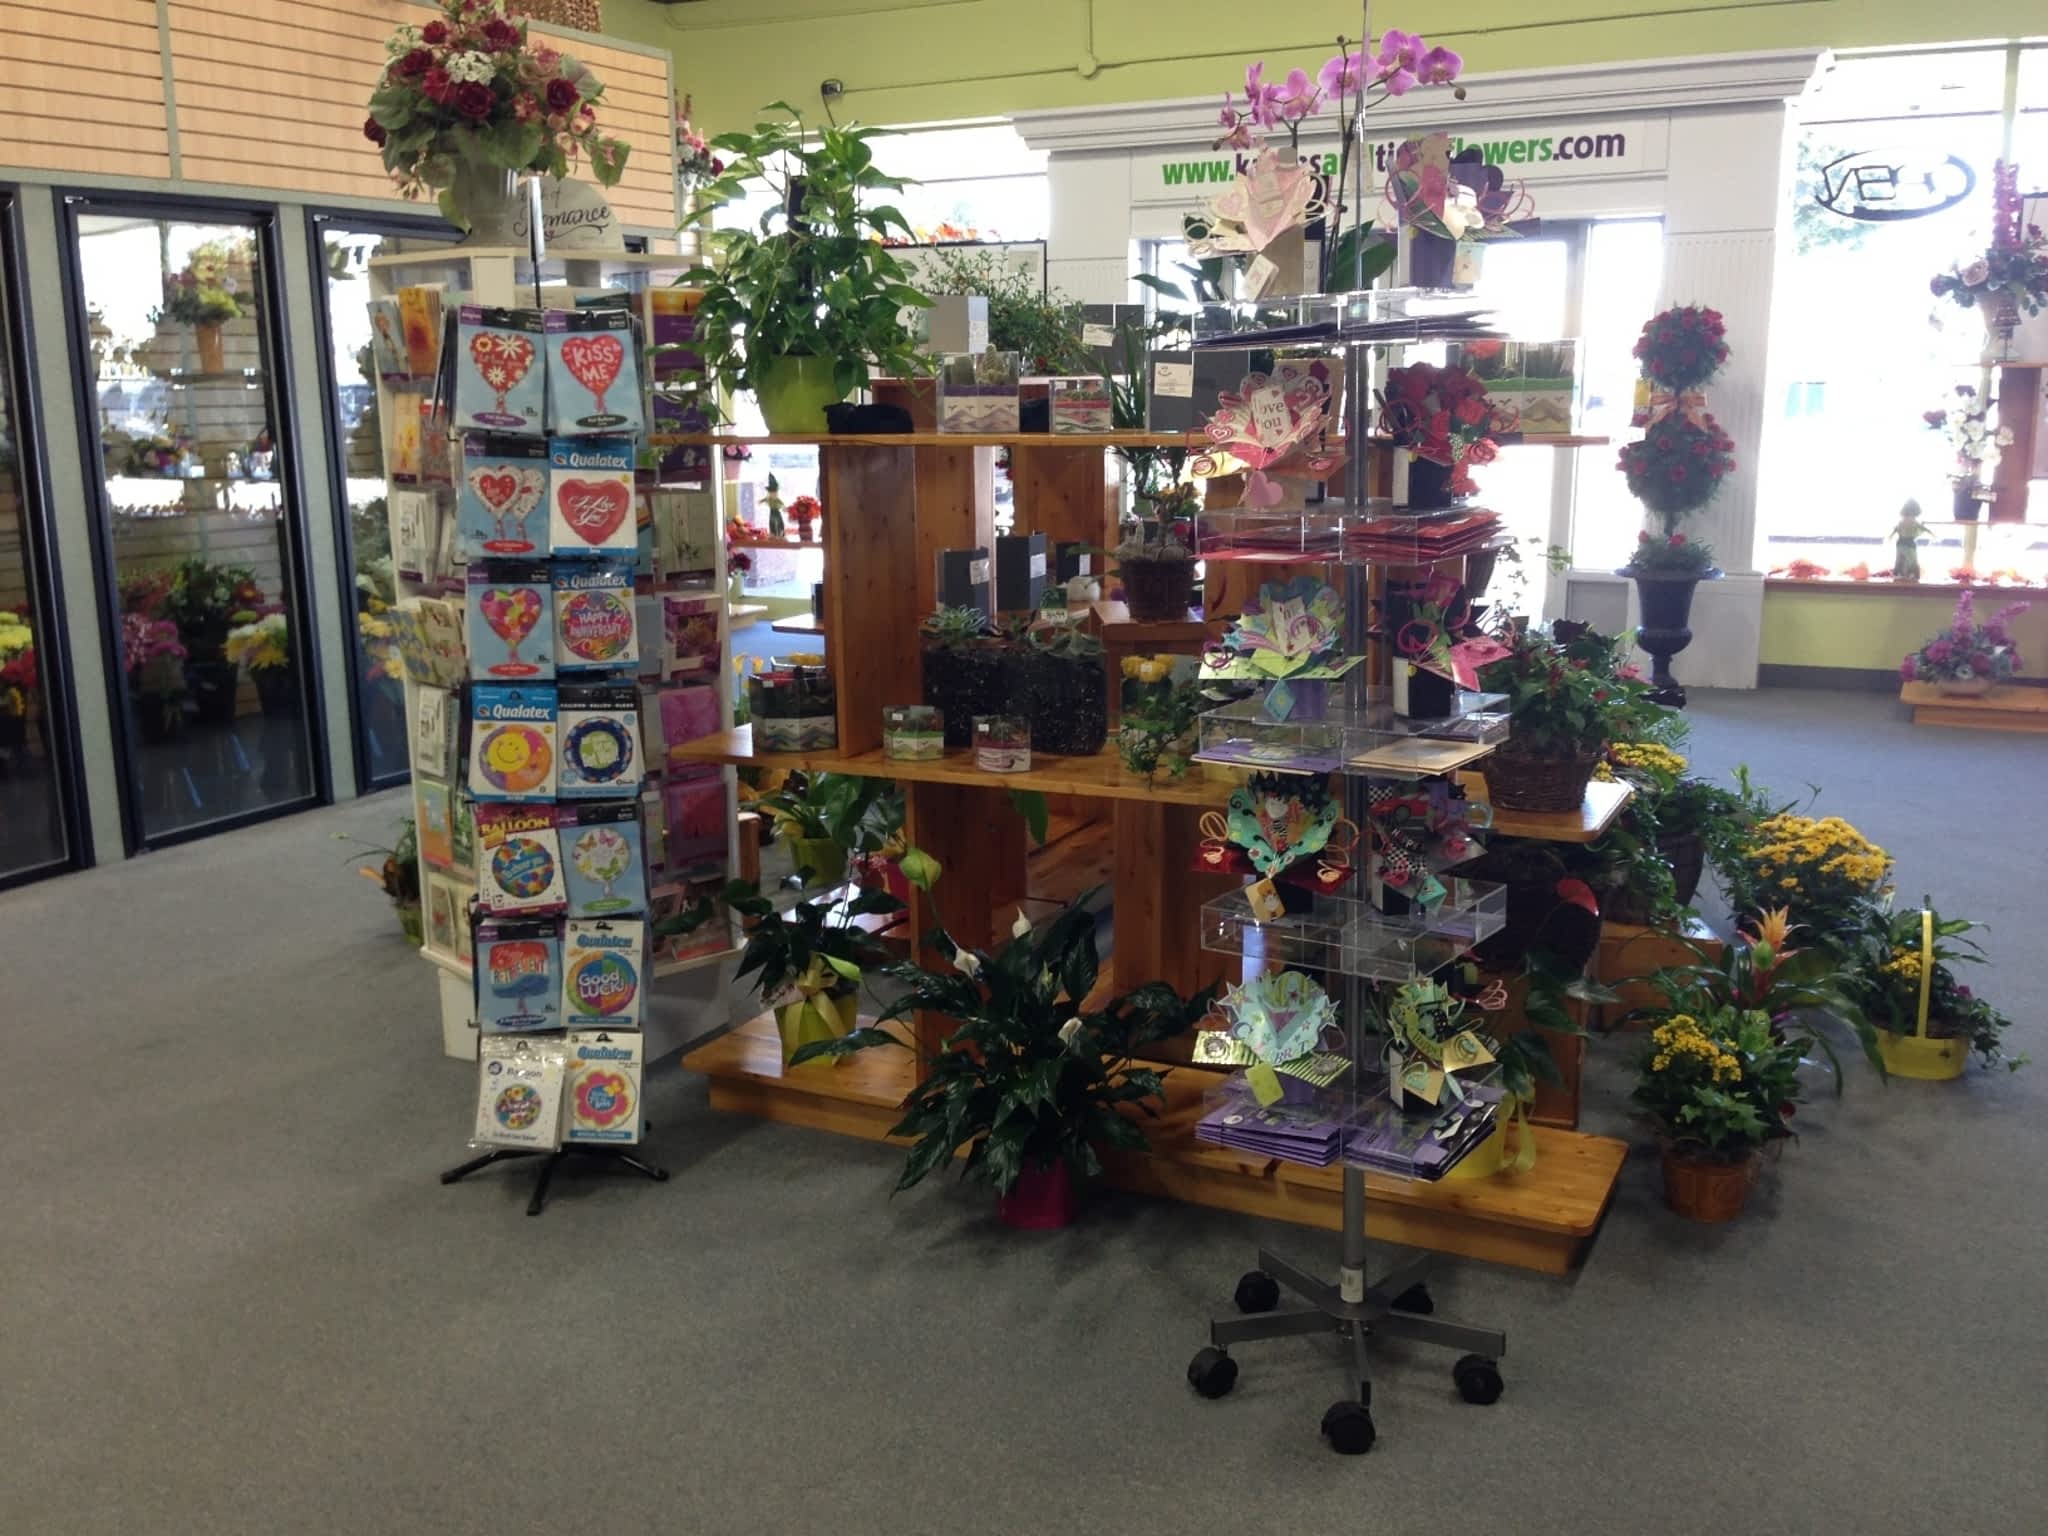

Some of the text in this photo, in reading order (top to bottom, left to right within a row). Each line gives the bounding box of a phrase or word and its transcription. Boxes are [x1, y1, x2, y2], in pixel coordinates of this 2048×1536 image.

[581, 364, 609, 382] ME
[570, 452, 627, 469] Qualatex
[571, 572, 627, 589] Qualatex
[492, 703, 550, 720] Qualatex
[480, 817, 550, 834] BALLOON
[579, 968, 620, 986] Good
